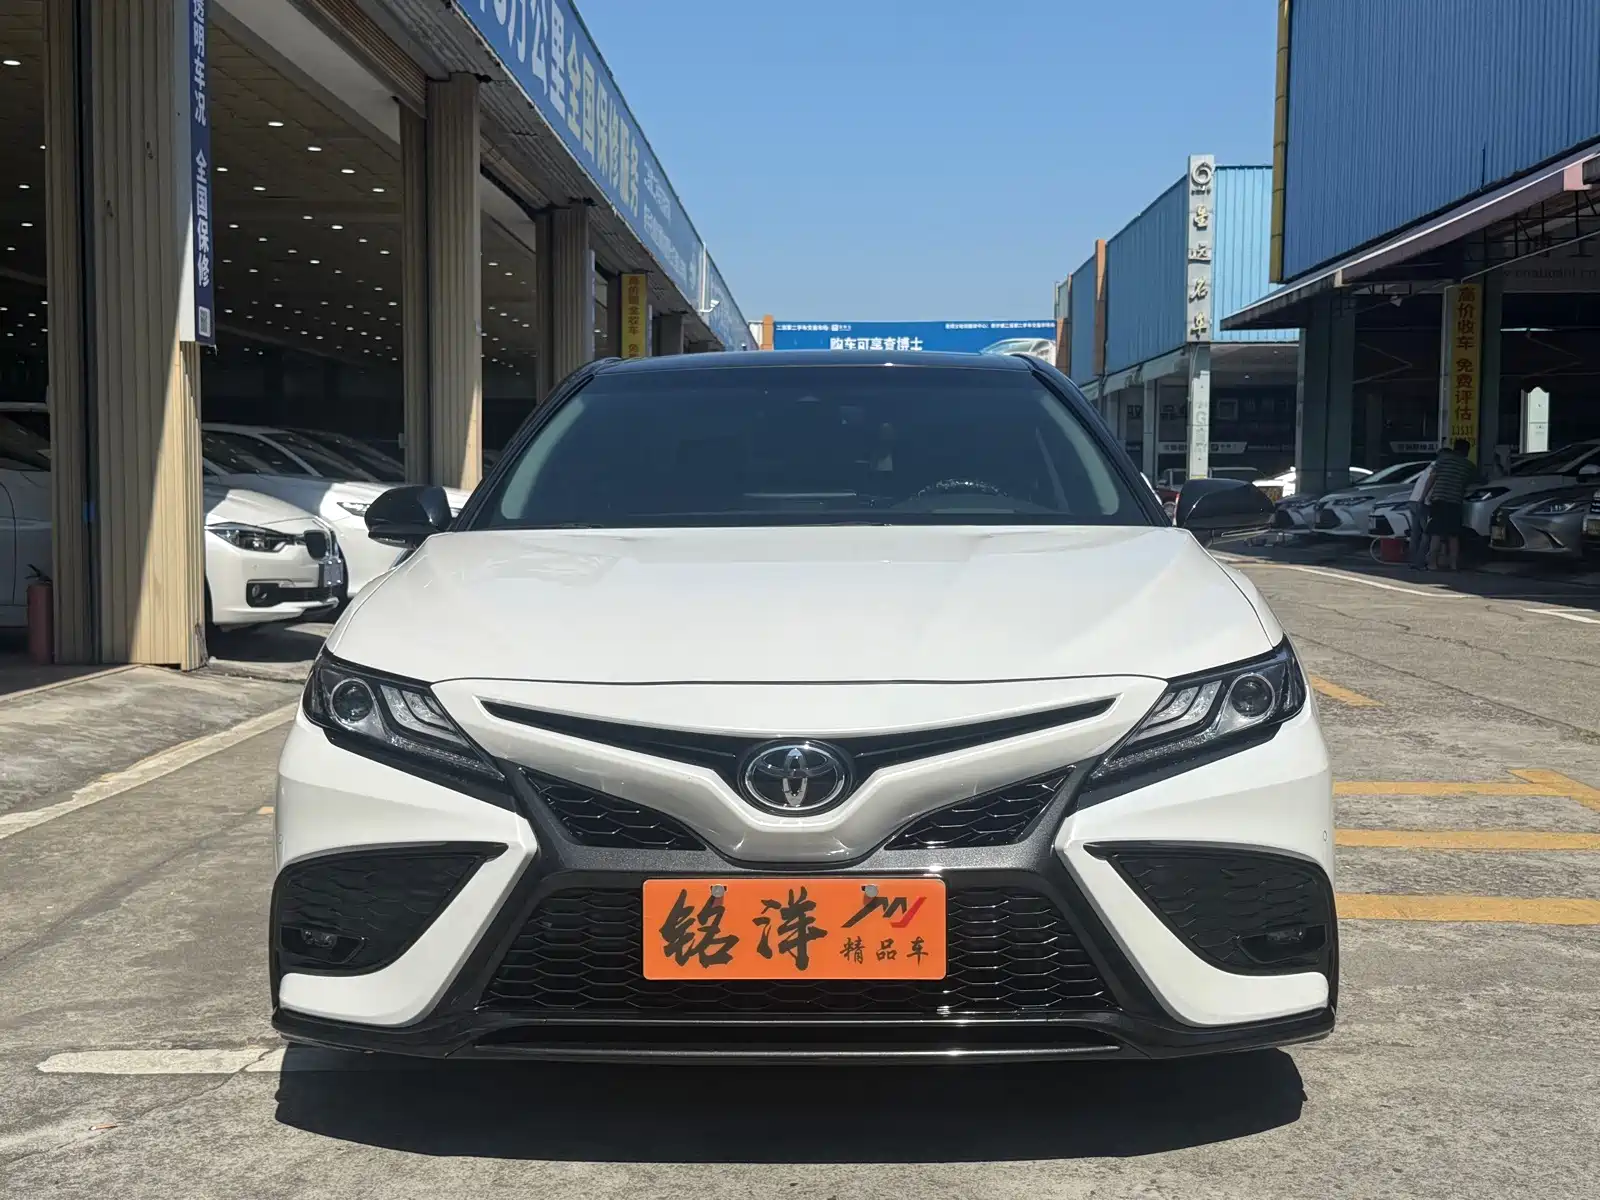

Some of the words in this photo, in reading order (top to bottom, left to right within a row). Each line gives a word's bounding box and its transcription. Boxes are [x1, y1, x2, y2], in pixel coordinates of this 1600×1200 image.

[196, 148, 210, 287] 全国保修
[1456, 286, 1475, 350] 高价收车
[1455, 358, 1473, 421] 免费评估
[659, 886, 828, 971] 铭洋
[840, 936, 929, 965] 精品车
